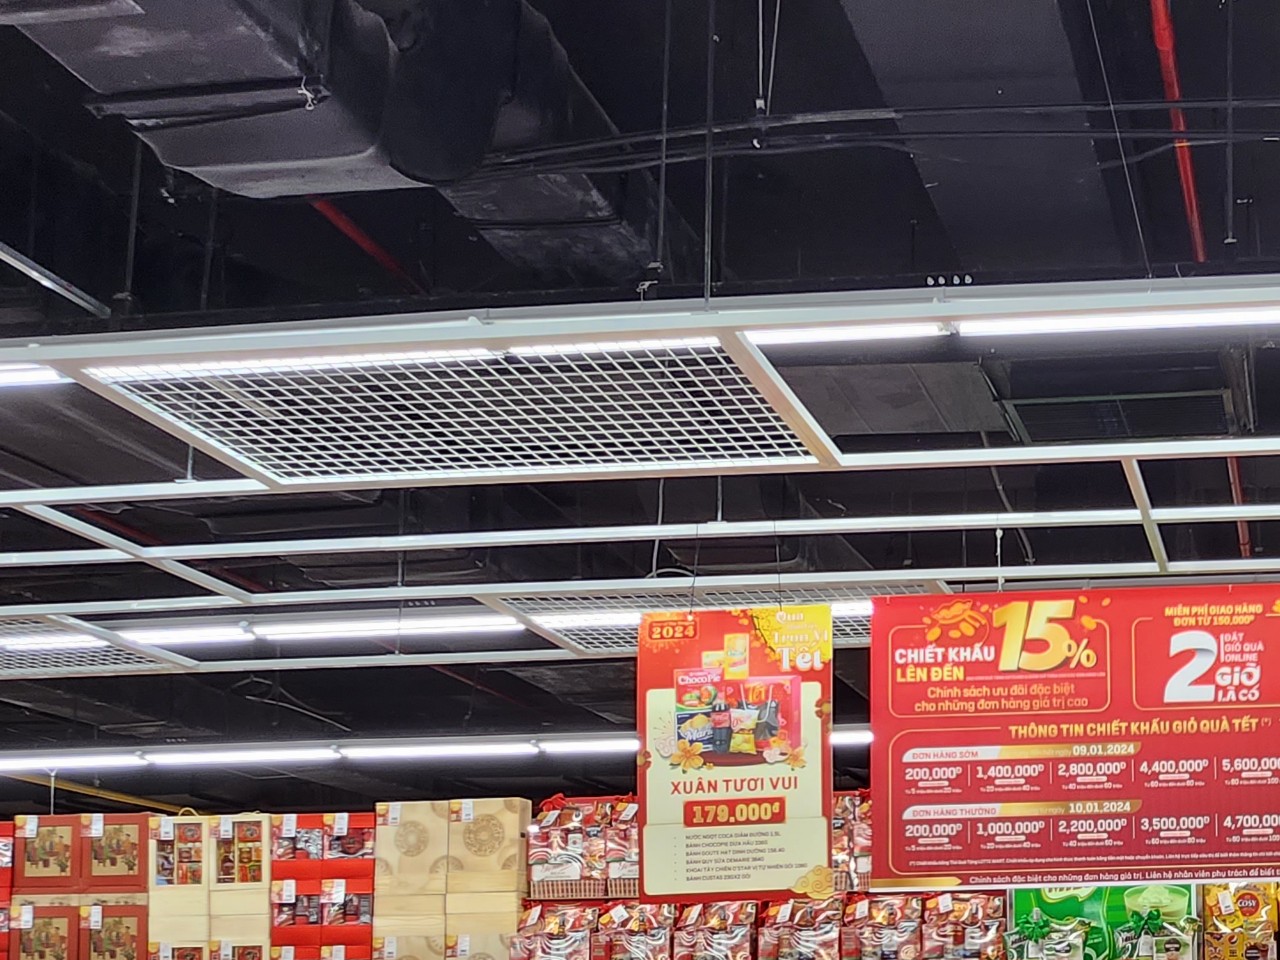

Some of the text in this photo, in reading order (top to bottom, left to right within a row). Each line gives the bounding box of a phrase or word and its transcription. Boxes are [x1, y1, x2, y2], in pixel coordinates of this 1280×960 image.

[1191, 603, 1208, 615] PHÍ
[1209, 605, 1233, 614] GIAO
[1235, 603, 1263, 614] HÀNG
[1173, 617, 1196, 627] ĐƠN
[1198, 615, 1212, 625] TỪ
[651, 626, 695, 638] 2024
[993, 600, 1097, 671] 15%
[895, 643, 995, 664] CHIẾT KHẤU
[1243, 641, 1265, 652] QUÀ
[776, 642, 824, 671] Tết
[1224, 653, 1259, 662] ONLINE
[896, 662, 965, 682] LÊN ĐẾN
[1163, 630, 1218, 703] 2
[927, 683, 1075, 699] Chính sách ưu đãi đặc biệt
[1218, 684, 1260, 702] LÀ CÓ
[914, 696, 1088, 713] cho những đơn hàng giá trị cao
[1009, 714, 1259, 740] THÔNG TIN CHIẾT KHẤU GIỎ QUÀ TẾT
[912, 744, 1135, 760] ĐƠN HÀNG SỚM 09.01.2024
[671, 776, 798, 795] XUÂN TƯƠI VUI
[912, 801, 1131, 818] ĐƠN HÀNG THƯỜNG 10.01.2024
[969, 874, 992, 884] Chính
[993, 875, 1011, 883] sách
[1027, 873, 1042, 882] biệt
[1044, 874, 1057, 882] cho
[1058, 872, 1083, 882] những
[1084, 872, 1098, 881] đơn
[1099, 872, 1119, 881] hàng
[1120, 871, 1132, 881] giá
